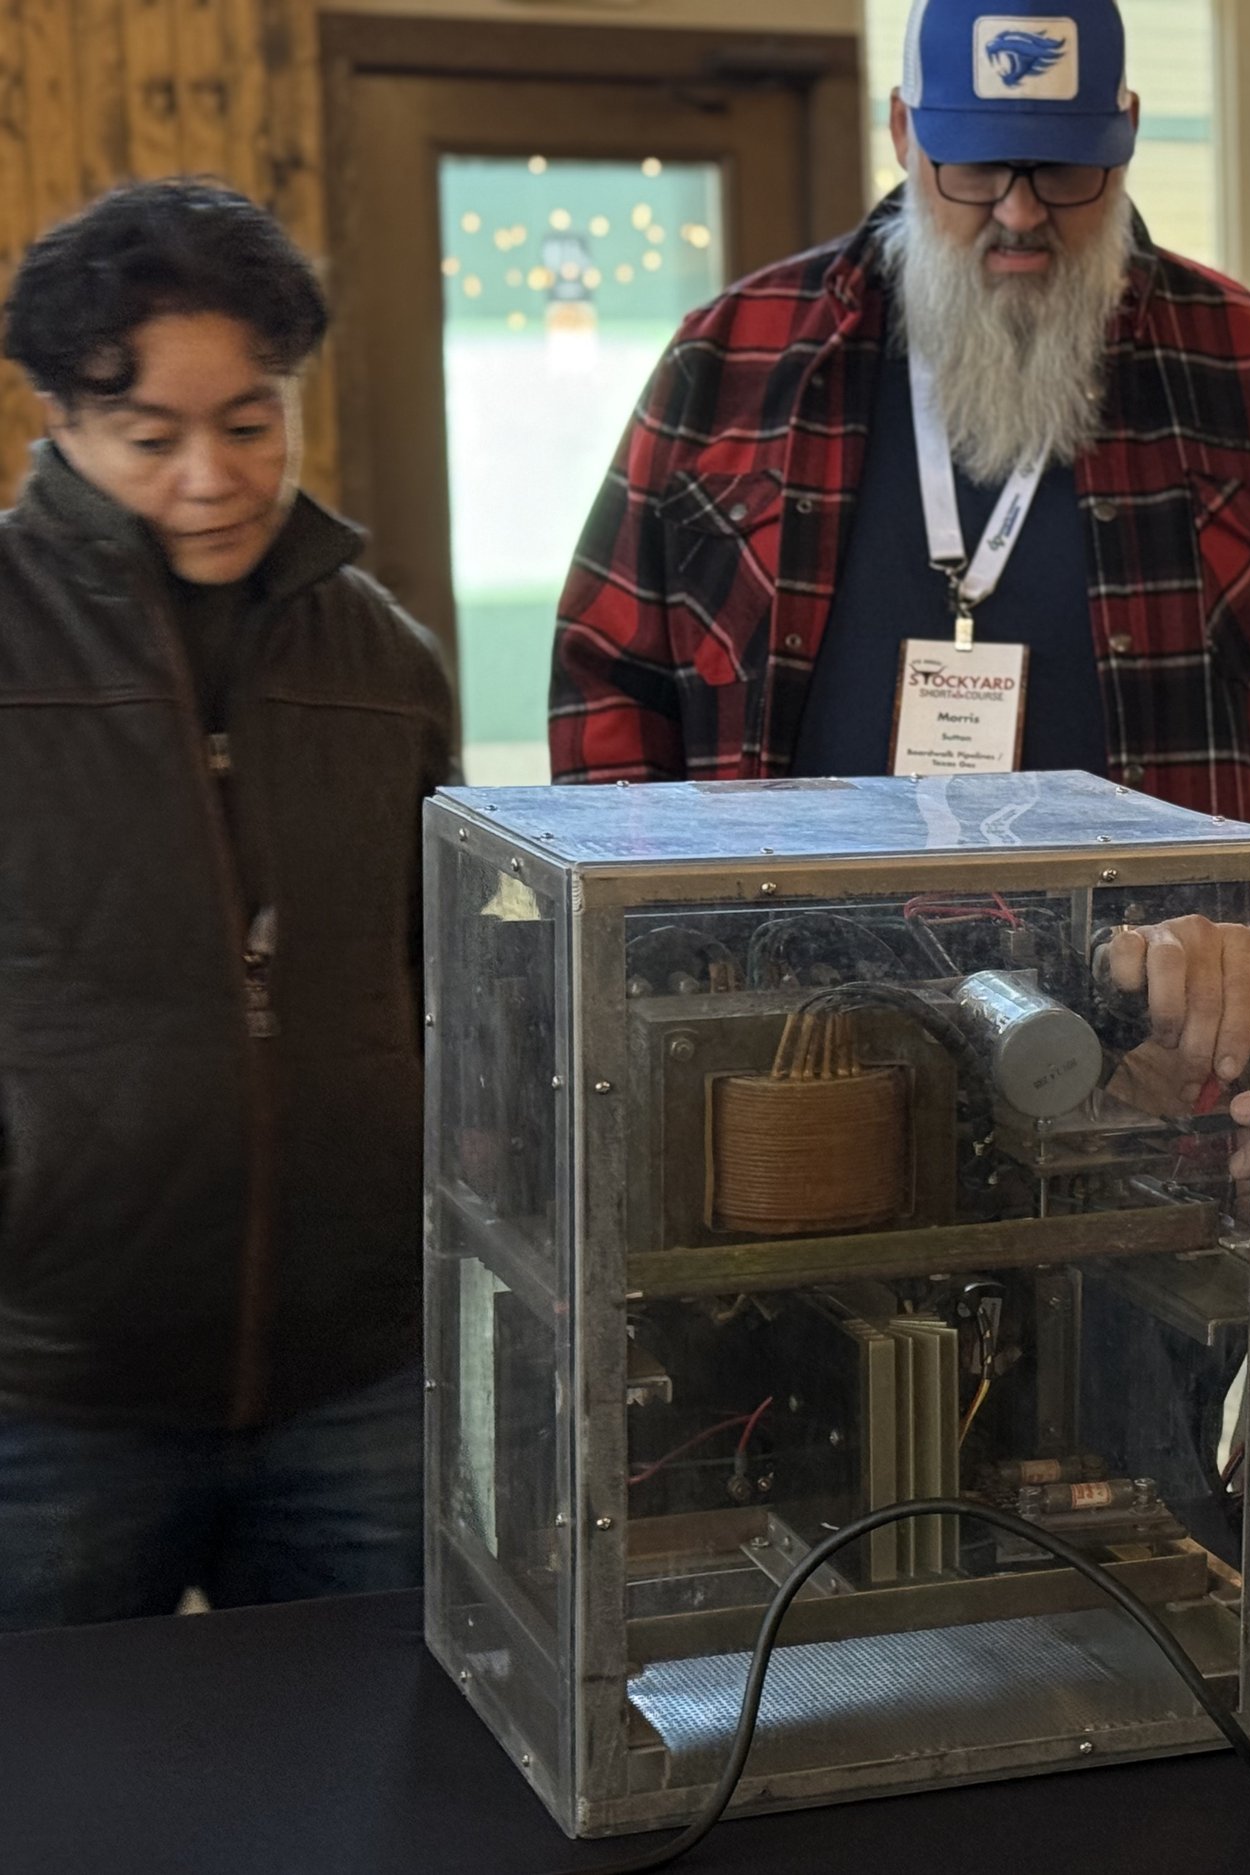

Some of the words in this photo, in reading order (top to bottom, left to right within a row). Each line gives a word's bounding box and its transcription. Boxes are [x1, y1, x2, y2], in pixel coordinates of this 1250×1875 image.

[908, 672, 1015, 691] STOCKYARD
[919, 688, 951, 699] SHORT
[965, 691, 1004, 702] COURSE
[937, 711, 980, 724] Morris
